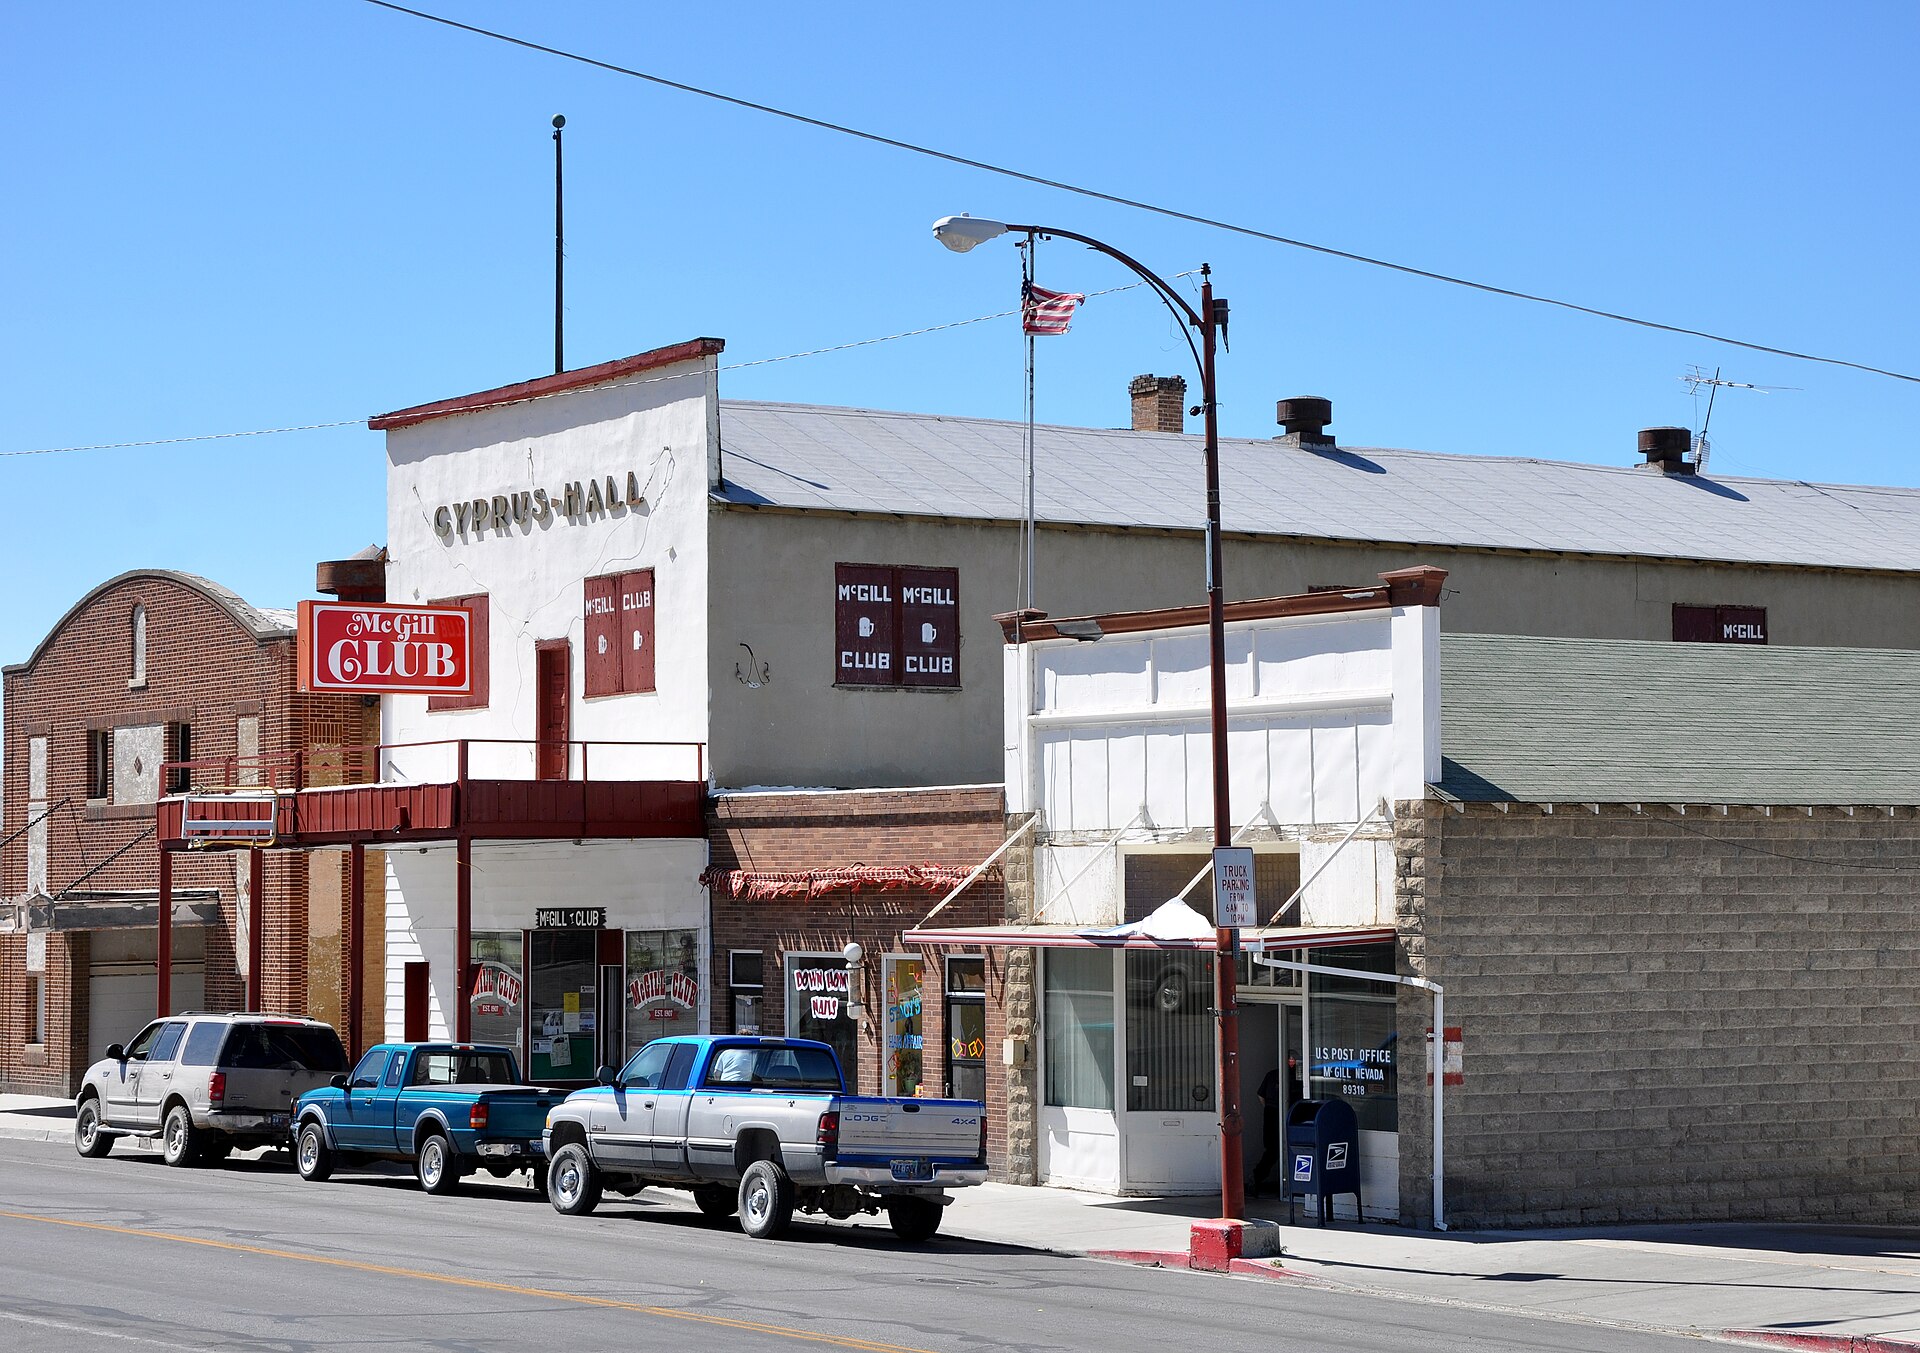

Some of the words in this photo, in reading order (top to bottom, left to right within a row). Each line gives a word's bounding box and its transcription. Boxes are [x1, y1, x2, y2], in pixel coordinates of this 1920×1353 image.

[585, 596, 615, 616] McGILL
[623, 590, 651, 611] CLUB
[838, 584, 892, 602] McGILL
[903, 586, 955, 605] McGILL
[346, 613, 435, 642] McGill
[1723, 624, 1764, 639] McGILL
[327, 639, 456, 683] CLUB
[841, 651, 890, 669] CLUB
[906, 655, 953, 673] CLUB
[1223, 865, 1248, 878] TRUCK
[1222, 879, 1250, 891] PARKING
[1229, 893, 1245, 902] FROM
[1242, 904, 1249, 913] TO
[539, 910, 568, 927] McGILL
[575, 910, 599, 926] CLUB
[497, 971, 521, 1007] CLUB
[629, 969, 666, 1010] McGILL
[670, 970, 699, 1010] CLUB
[794, 968, 824, 991] DOWN
[824, 968, 849, 992] HOM
[810, 996, 838, 1020] NAILS
[1331, 1048, 1354, 1061] POST
[1359, 1049, 1391, 1063] OFFICE
[1355, 1068, 1384, 1081] NEVADA
[1342, 1084, 1365, 1095] 89318
